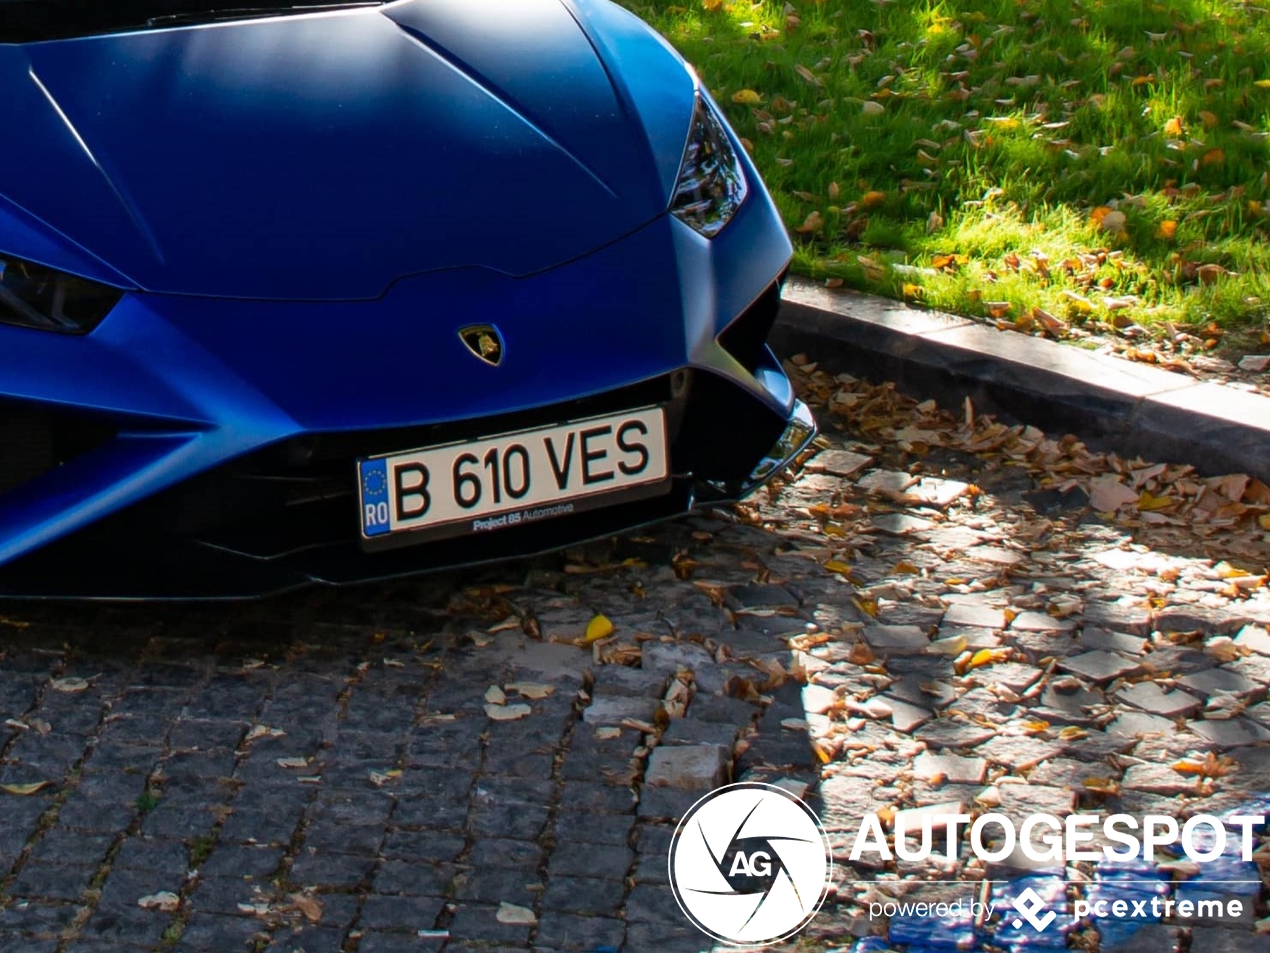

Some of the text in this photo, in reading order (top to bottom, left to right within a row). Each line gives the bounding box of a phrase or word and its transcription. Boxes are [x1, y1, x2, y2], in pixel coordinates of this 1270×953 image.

[394, 419, 649, 521] B 610 VES
[365, 502, 388, 526] RO
[473, 503, 574, 531] Project 85 Automotive
